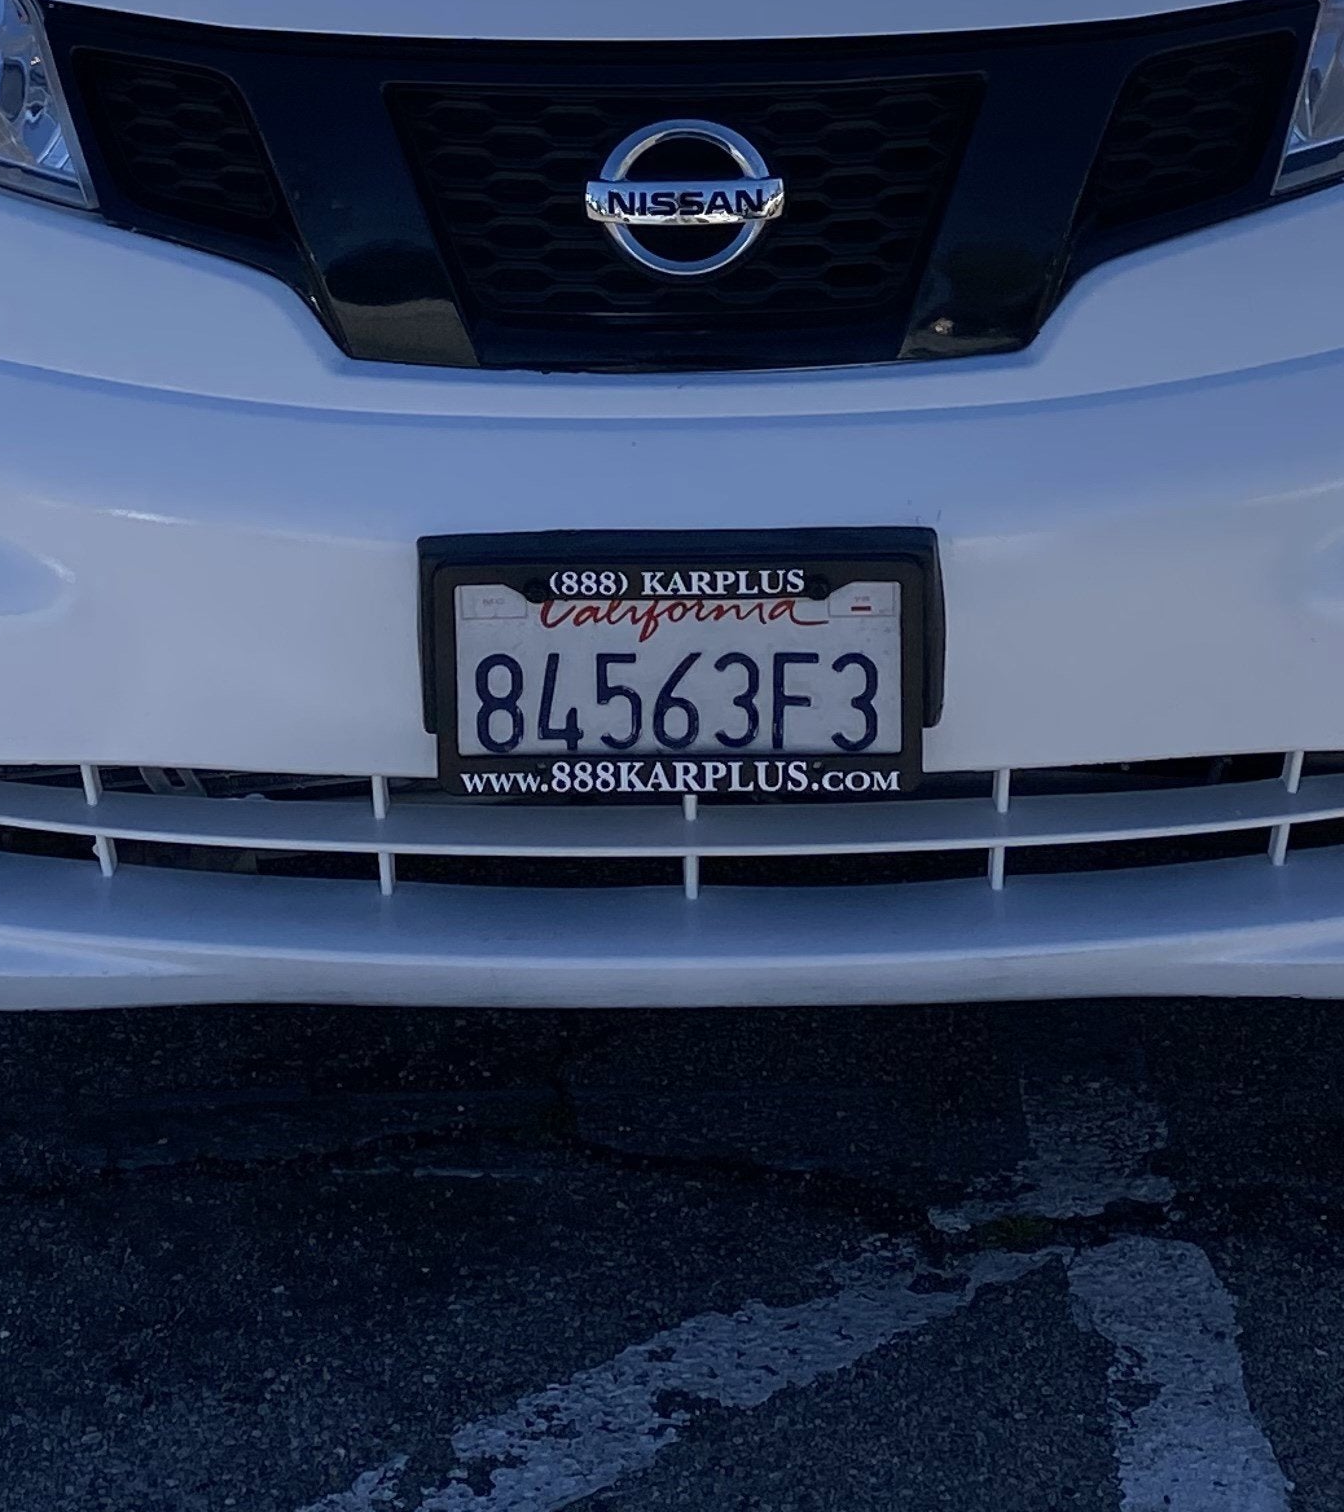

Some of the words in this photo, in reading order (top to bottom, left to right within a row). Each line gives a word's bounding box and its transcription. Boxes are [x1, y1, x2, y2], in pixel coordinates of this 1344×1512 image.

[607, 188, 764, 217] NISSAN
[548, 570, 629, 597] (888)
[641, 568, 805, 596] KARPLUS
[540, 598, 830, 643] California
[474, 651, 879, 753] 84563F3
